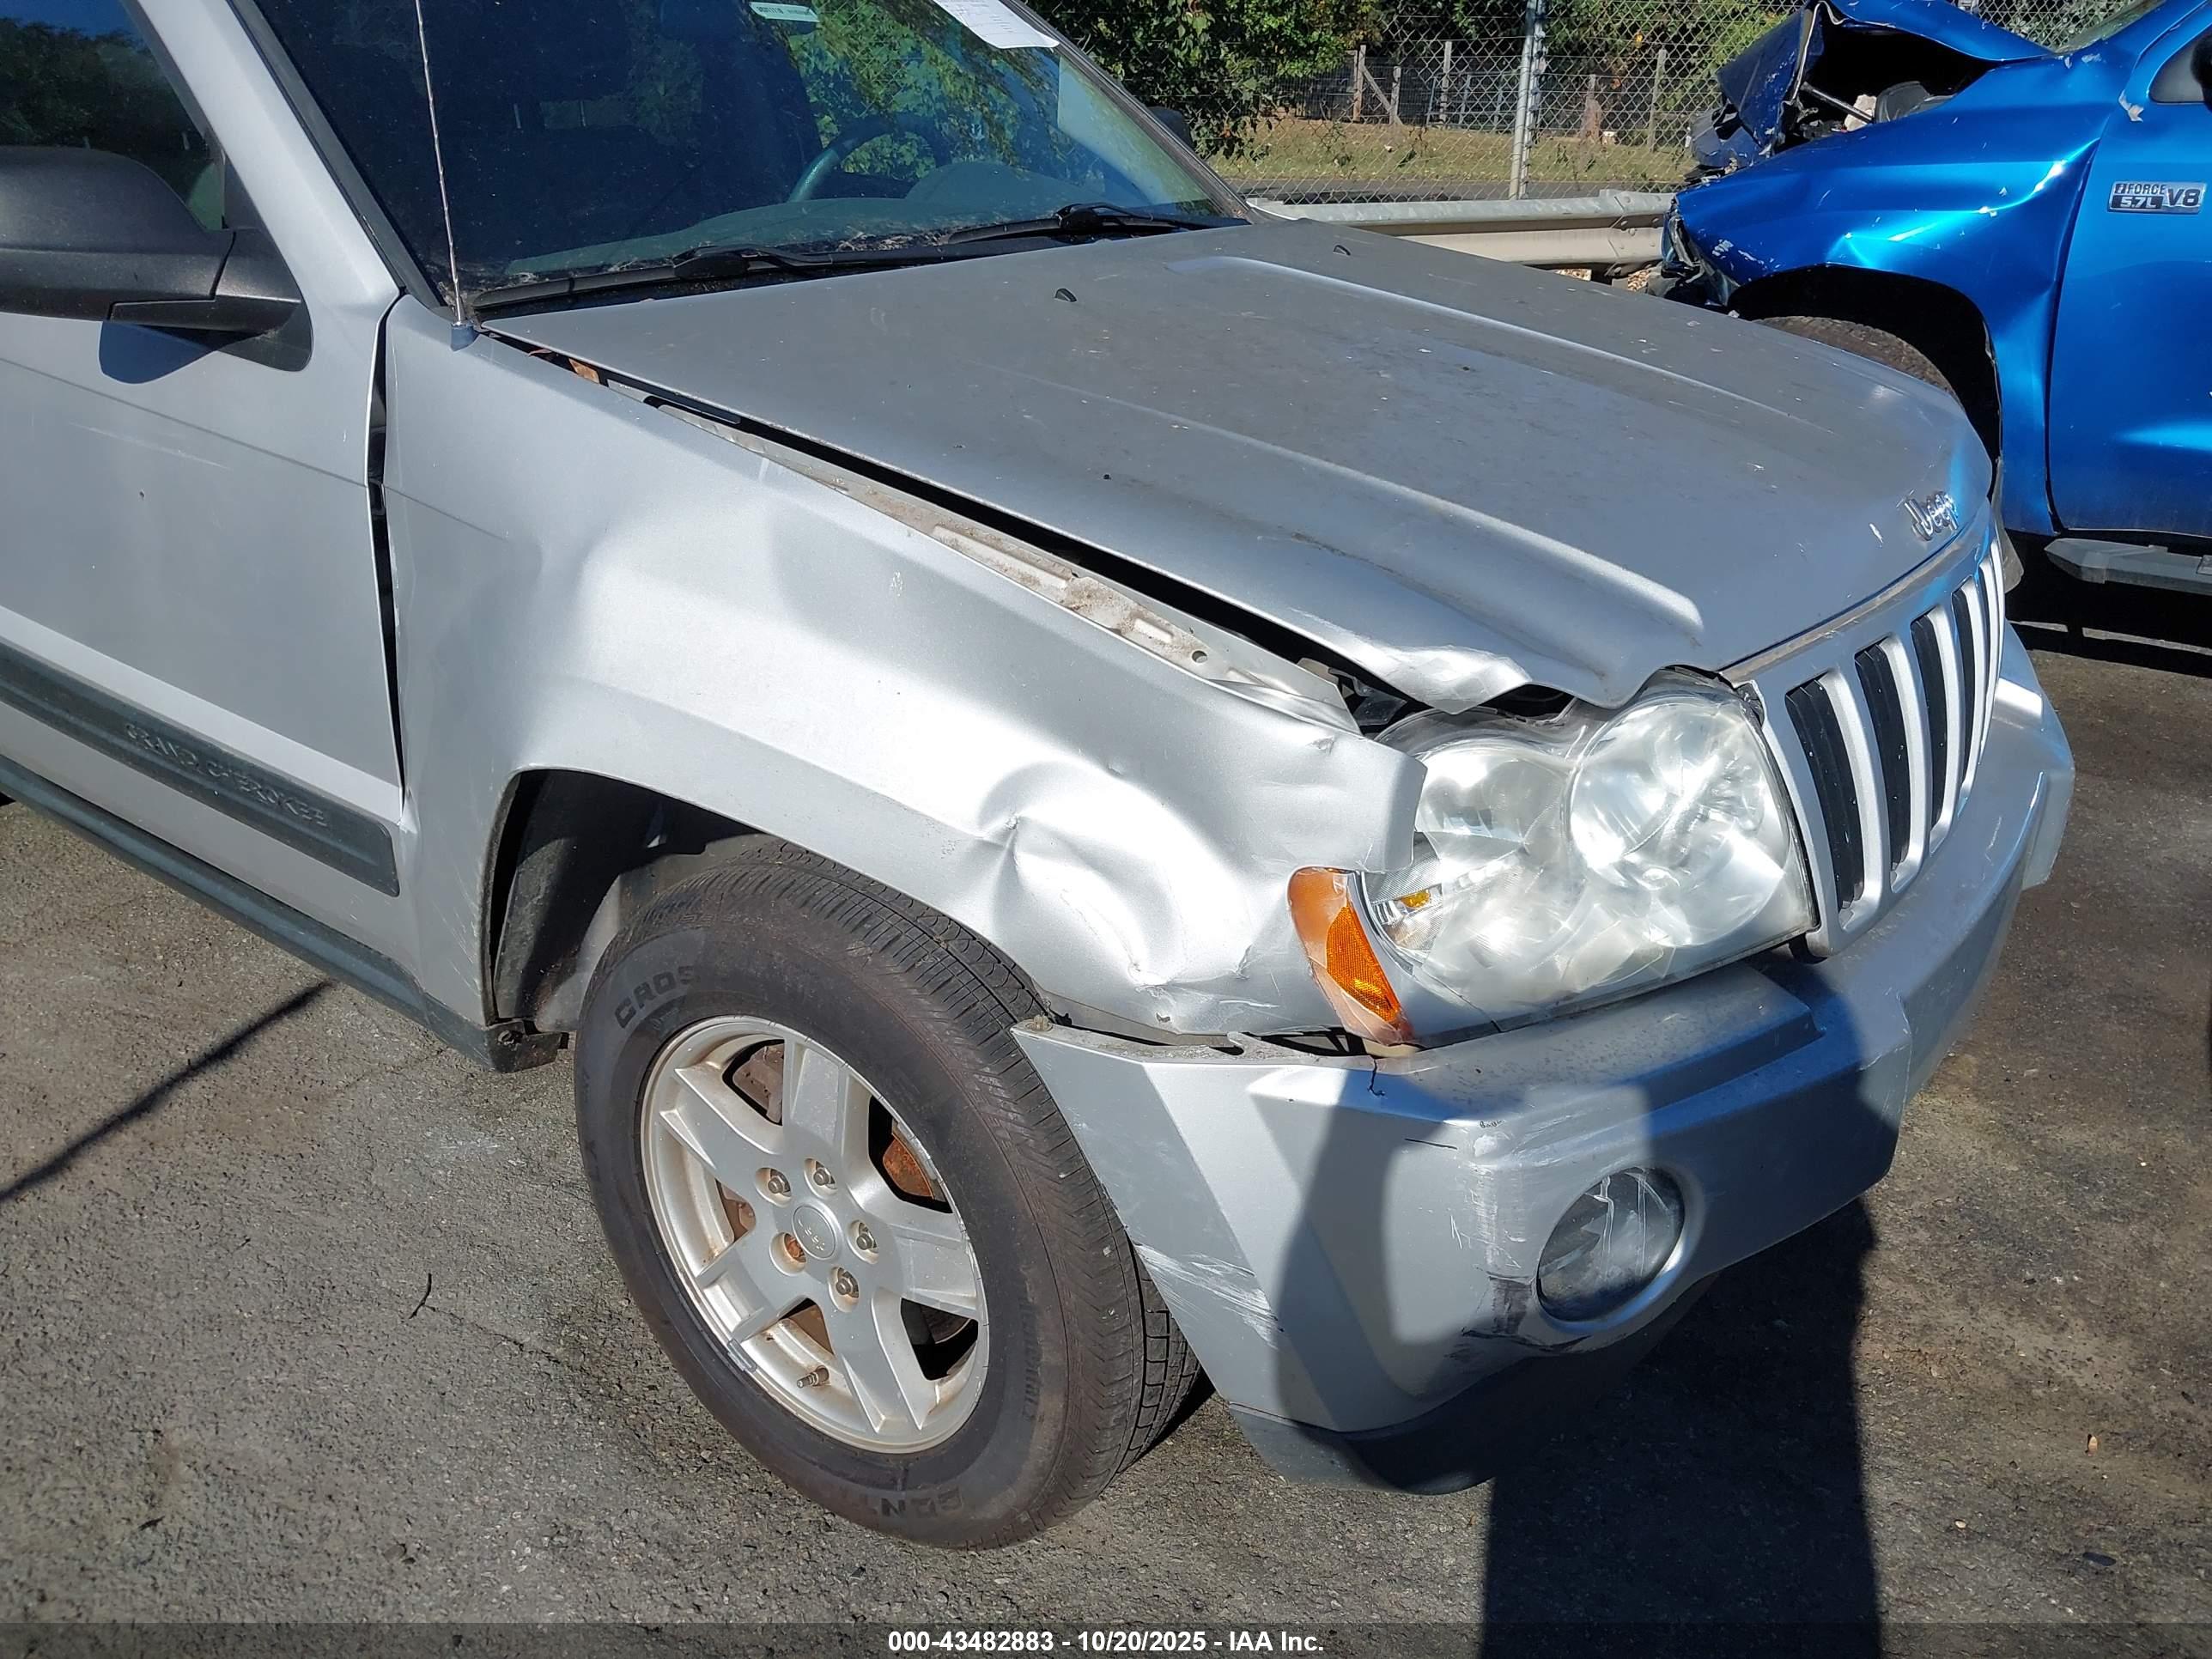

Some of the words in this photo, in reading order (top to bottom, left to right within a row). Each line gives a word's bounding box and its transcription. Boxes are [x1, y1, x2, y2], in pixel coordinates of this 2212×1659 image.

[2119, 196, 2158, 208] 5.7L
[2167, 188, 2201, 206] V8
[1905, 493, 1959, 538] Jeep
